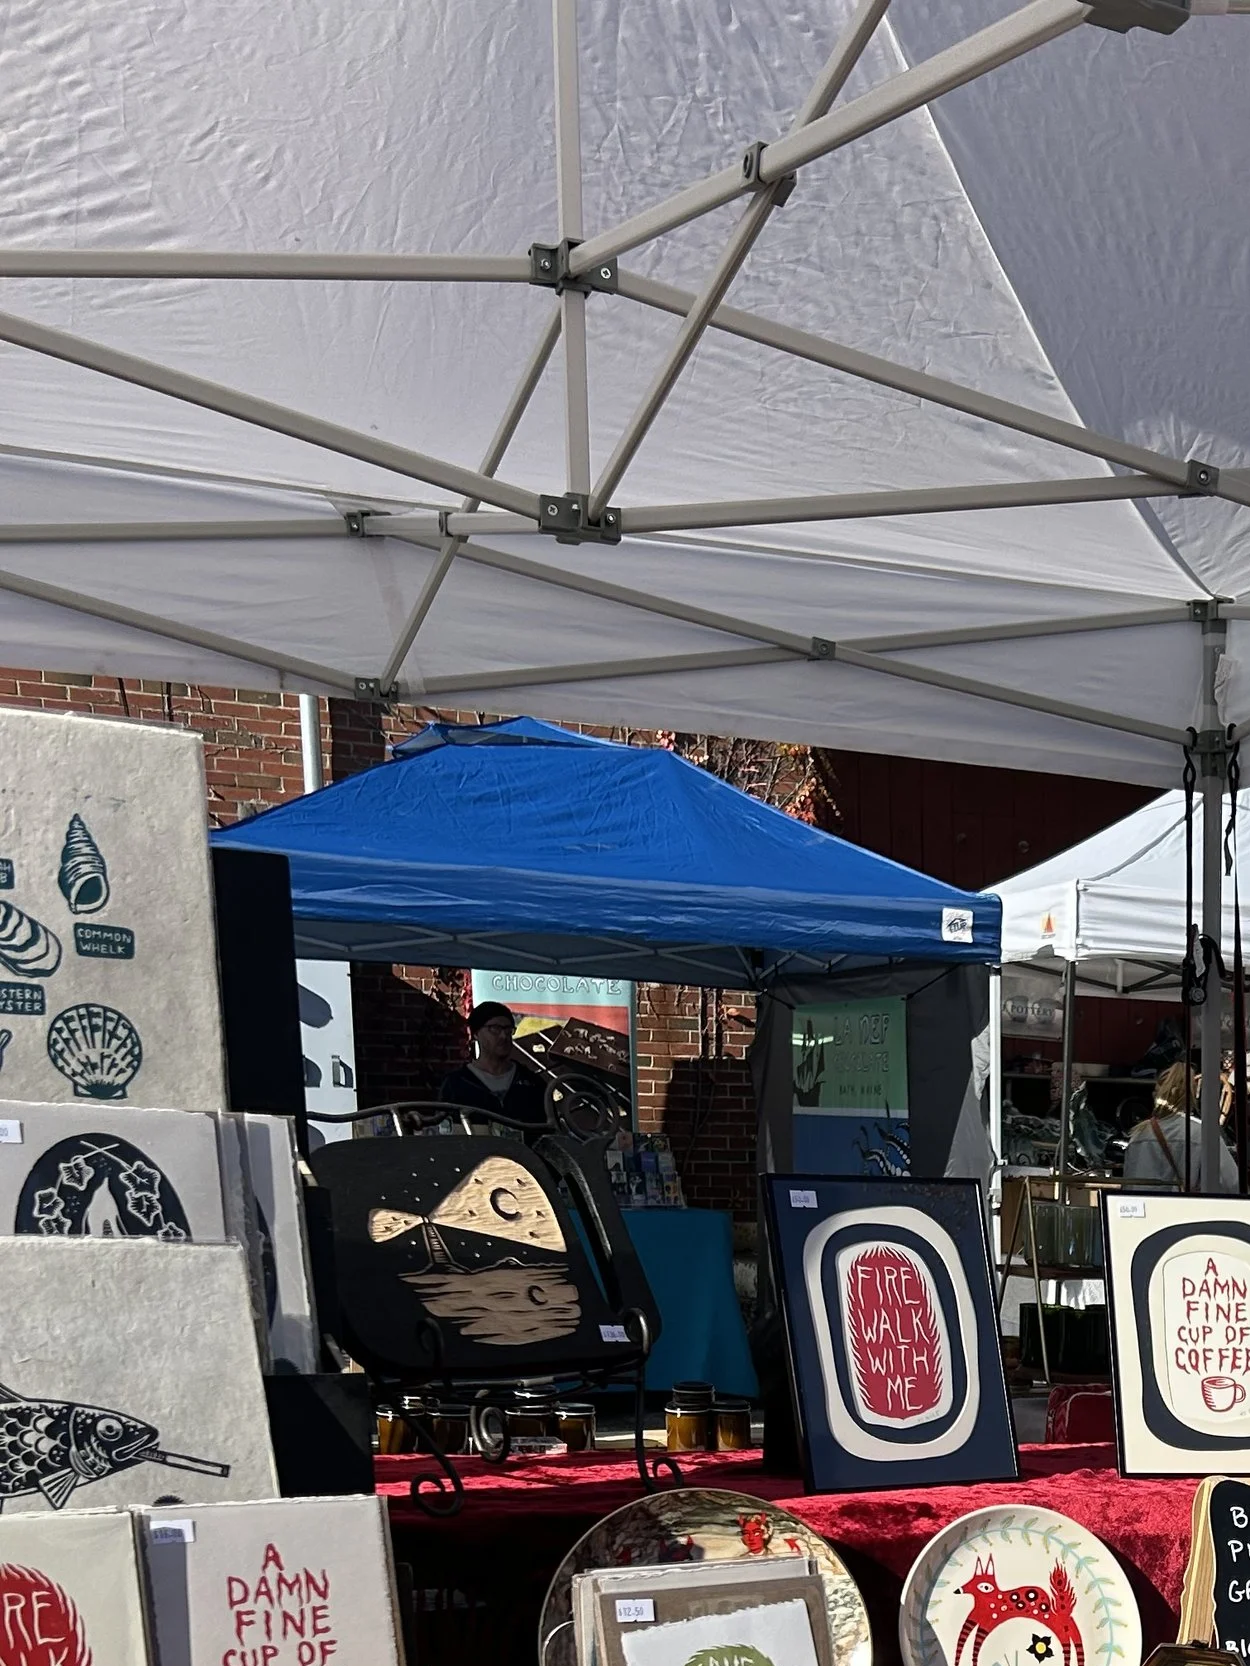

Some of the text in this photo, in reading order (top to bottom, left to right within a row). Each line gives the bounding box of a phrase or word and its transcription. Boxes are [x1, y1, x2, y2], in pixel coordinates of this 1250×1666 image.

[77, 928, 132, 944] COMMON
[79, 941, 127, 955] WHELK
[492, 974, 621, 995] CHOCOLATE
[1204, 1257, 1218, 1276] A
[857, 1265, 920, 1309] FIRE
[1182, 1276, 1247, 1300] DAMN
[1186, 1300, 1247, 1324] FINE
[858, 1307, 930, 1345] WALK
[1177, 1325, 1250, 1345] CUP OF
[867, 1345, 929, 1376] WITH
[887, 1375, 923, 1411] ME
[262, 1543, 284, 1573] A
[227, 1568, 330, 1610] DAMN
[235, 1605, 332, 1646] FINE
